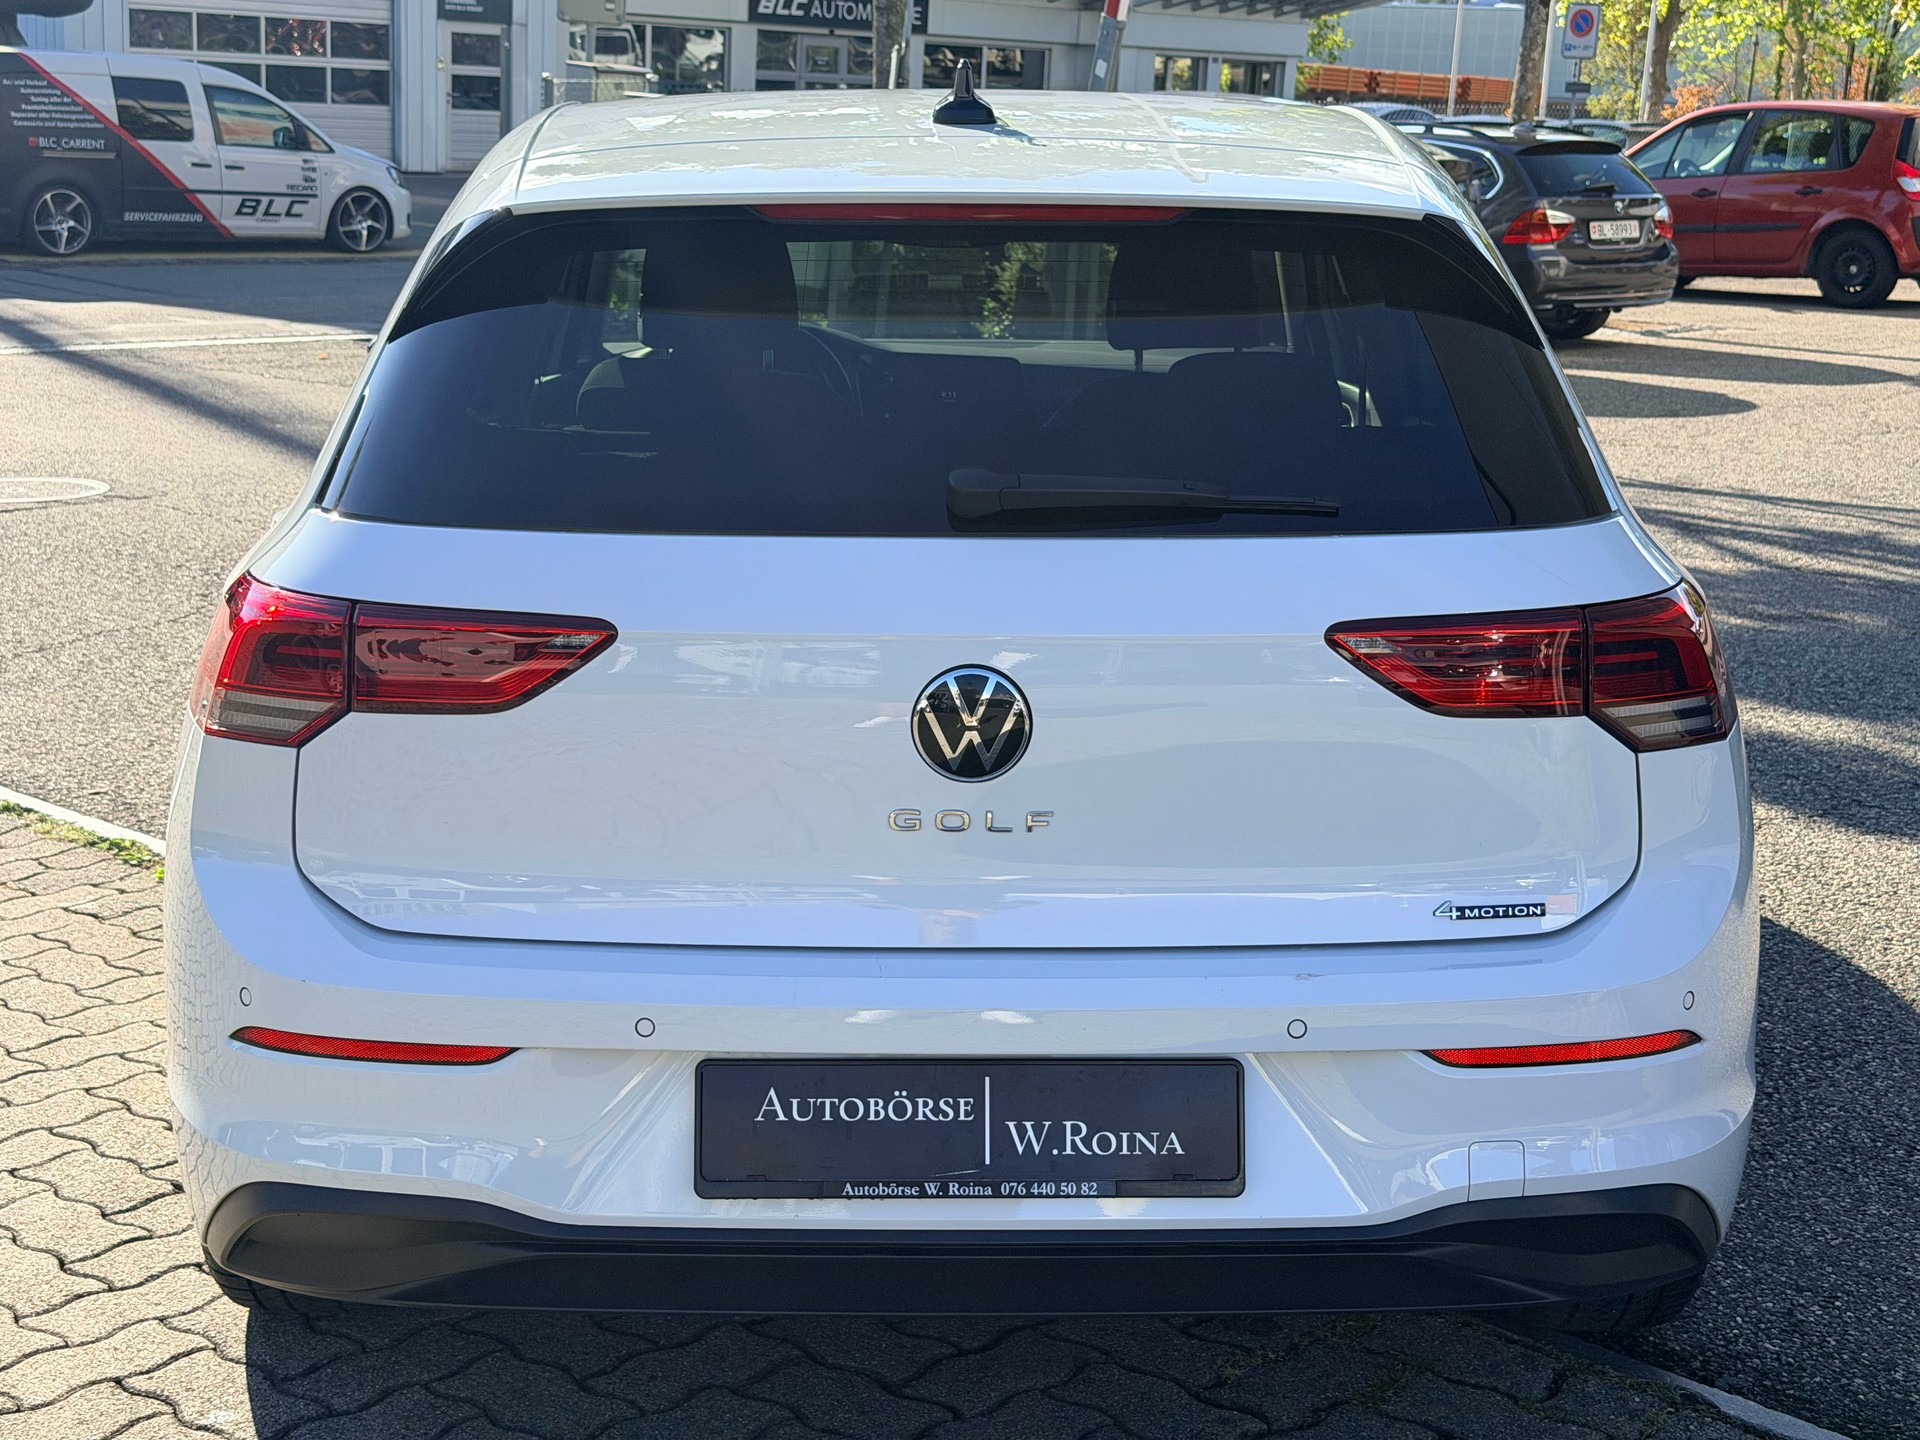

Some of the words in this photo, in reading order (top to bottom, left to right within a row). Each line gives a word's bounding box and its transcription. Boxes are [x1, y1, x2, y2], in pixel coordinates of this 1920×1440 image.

[38, 136, 105, 151] BLC_CARRENT
[235, 197, 309, 218] BLC
[123, 211, 203, 223] SERVICEFAHRZEUG
[888, 808, 1055, 833] GOLF
[841, 1181, 920, 1196] Autobörse
[924, 1182, 943, 1196] W.
[948, 1182, 993, 1196] Roina
[1000, 1182, 1027, 1196] 076
[1030, 1182, 1056, 1196] 440
[1059, 1182, 1076, 1196] 50
[1081, 1182, 1098, 1196] 82
